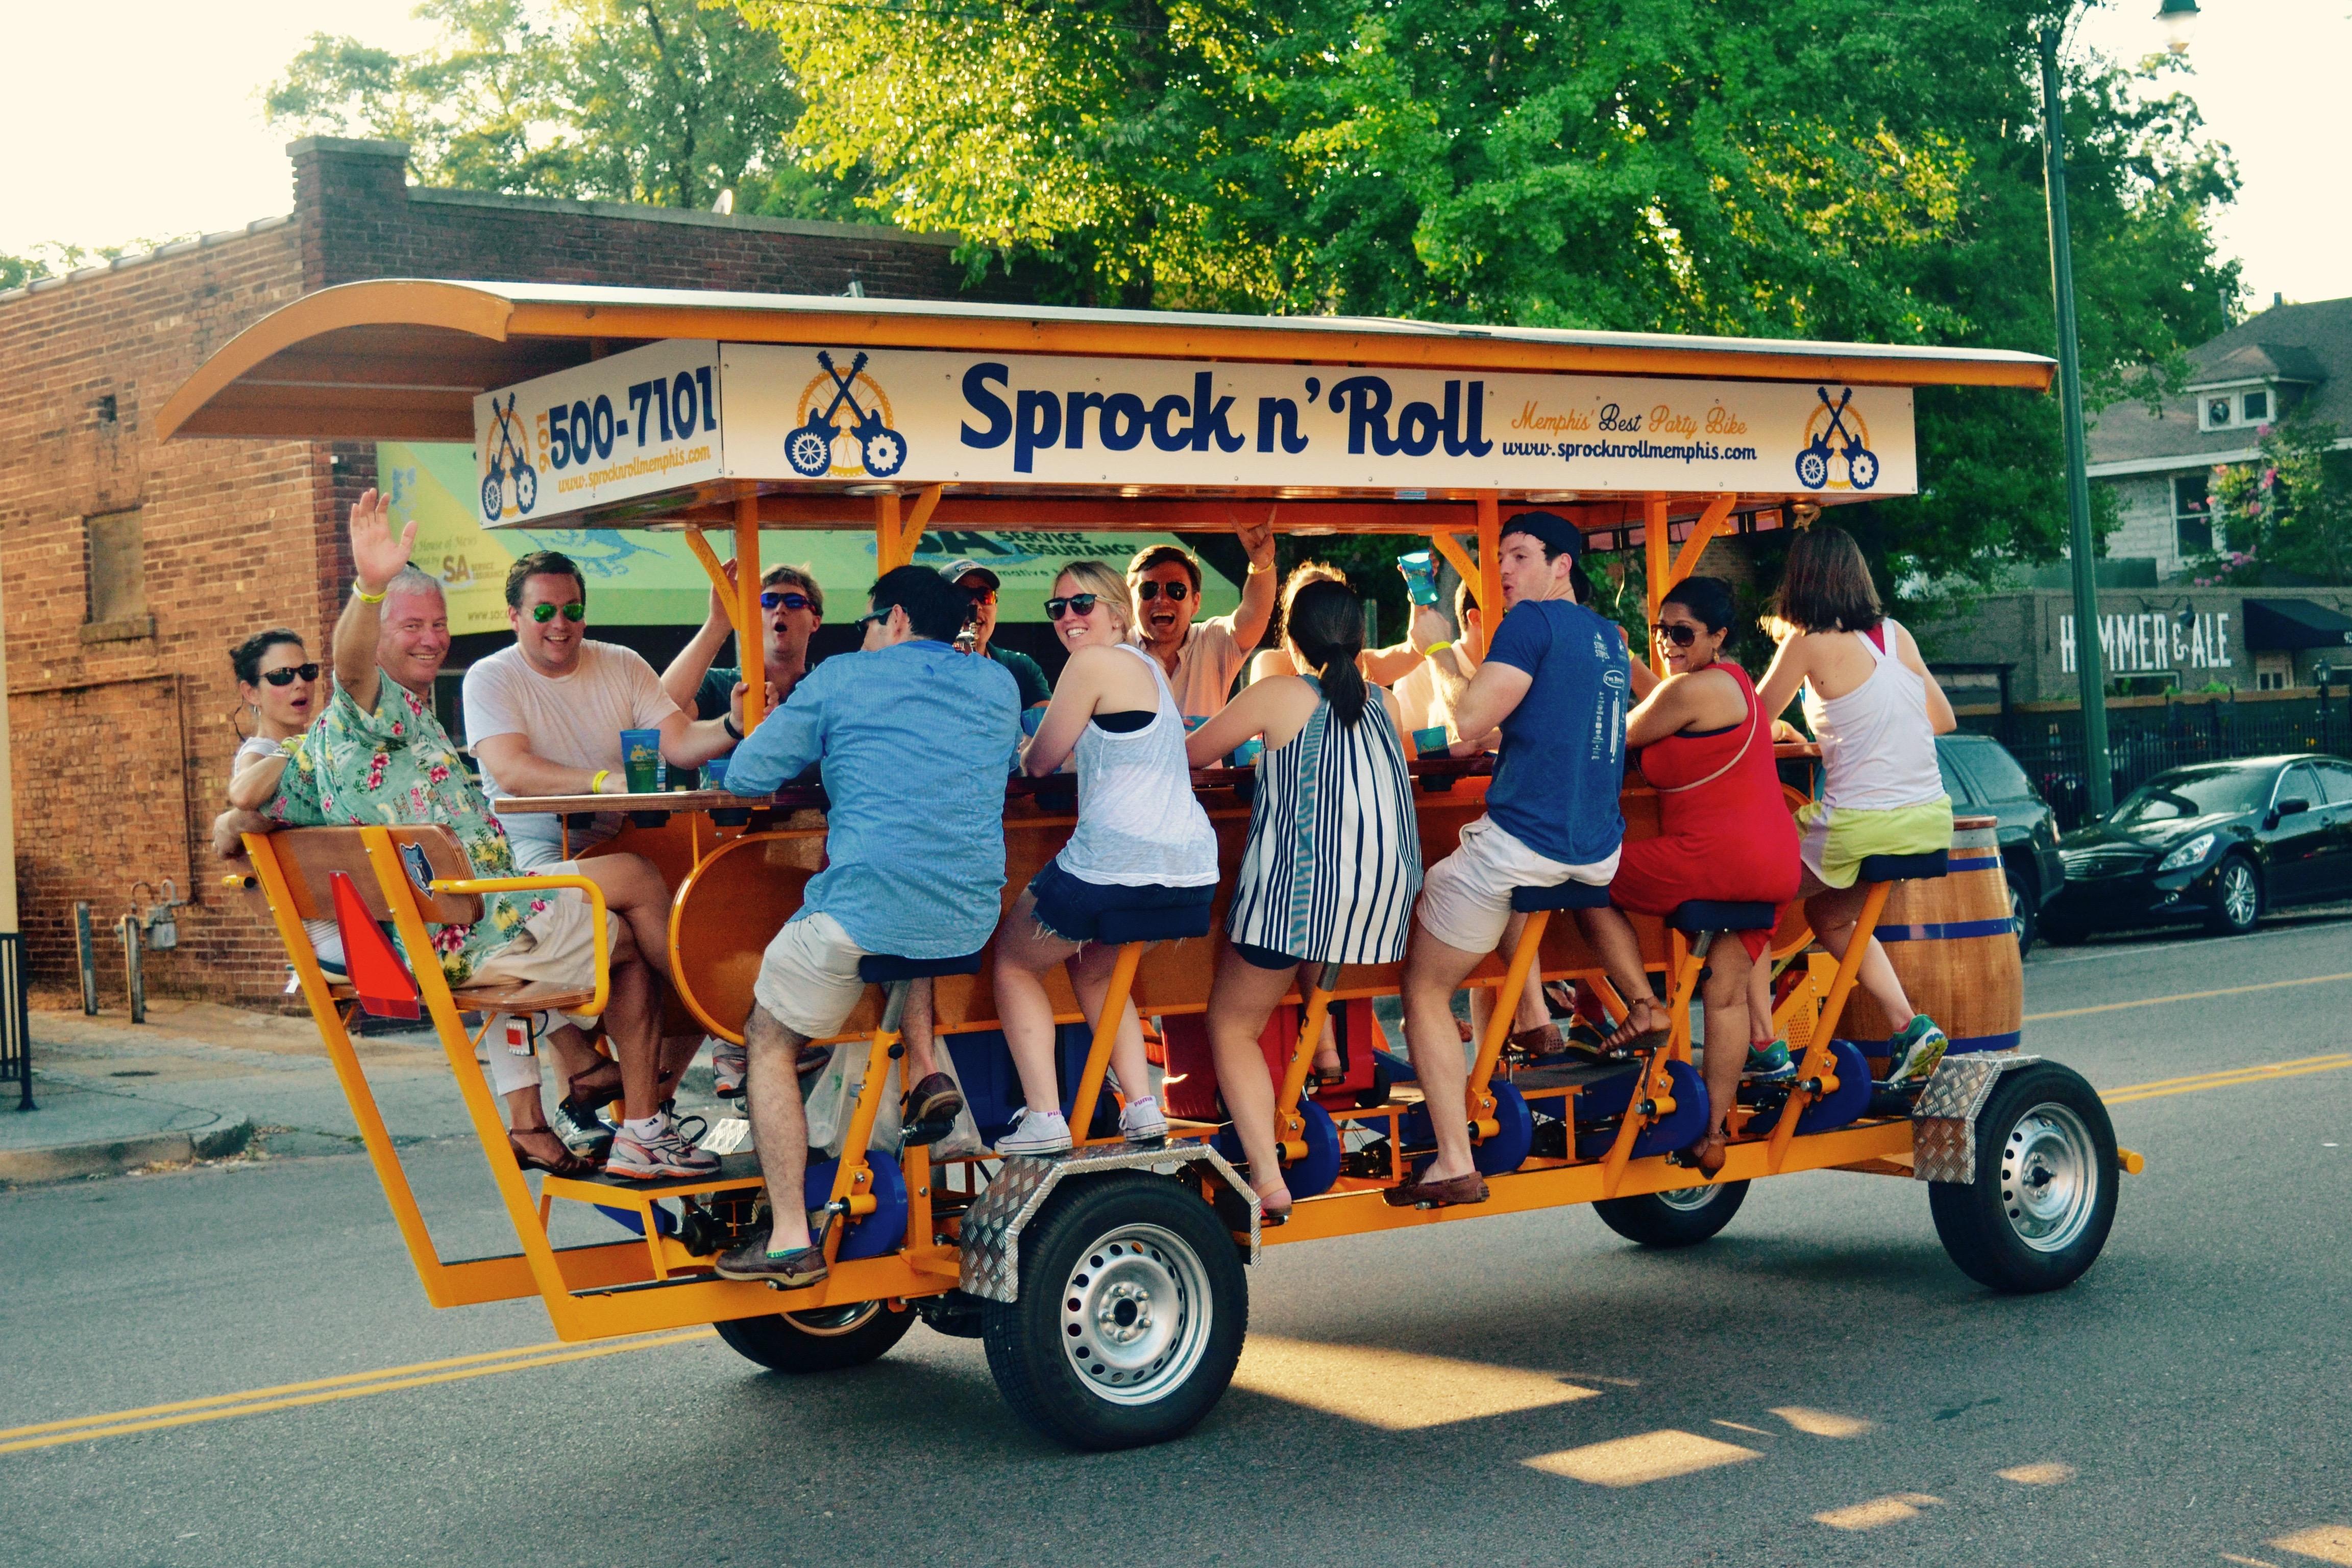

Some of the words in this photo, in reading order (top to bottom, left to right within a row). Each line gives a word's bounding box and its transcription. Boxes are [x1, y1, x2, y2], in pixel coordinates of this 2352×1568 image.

[549, 365, 717, 470] 500-7101
[961, 363, 1245, 473] Sprock
[1329, 376, 1494, 457] Roll
[1511, 401, 1595, 436] Memphis'
[1599, 403, 1643, 432] Best
[1649, 405, 1698, 439] Party
[1705, 406, 1748, 435] Bike
[536, 410, 551, 474] 901
[1502, 439, 1757, 463] www.sprocknrollmemphis.com
[558, 446, 712, 494] www.sprocknrollmemphis.com
[995, 531, 1091, 545] SERVICE
[1013, 543, 1138, 556] ASSURANCE
[443, 555, 470, 582] SA
[2060, 614, 2168, 673] HMMER
[2172, 622, 2189, 660] &
[2192, 612, 2231, 668] ALE
